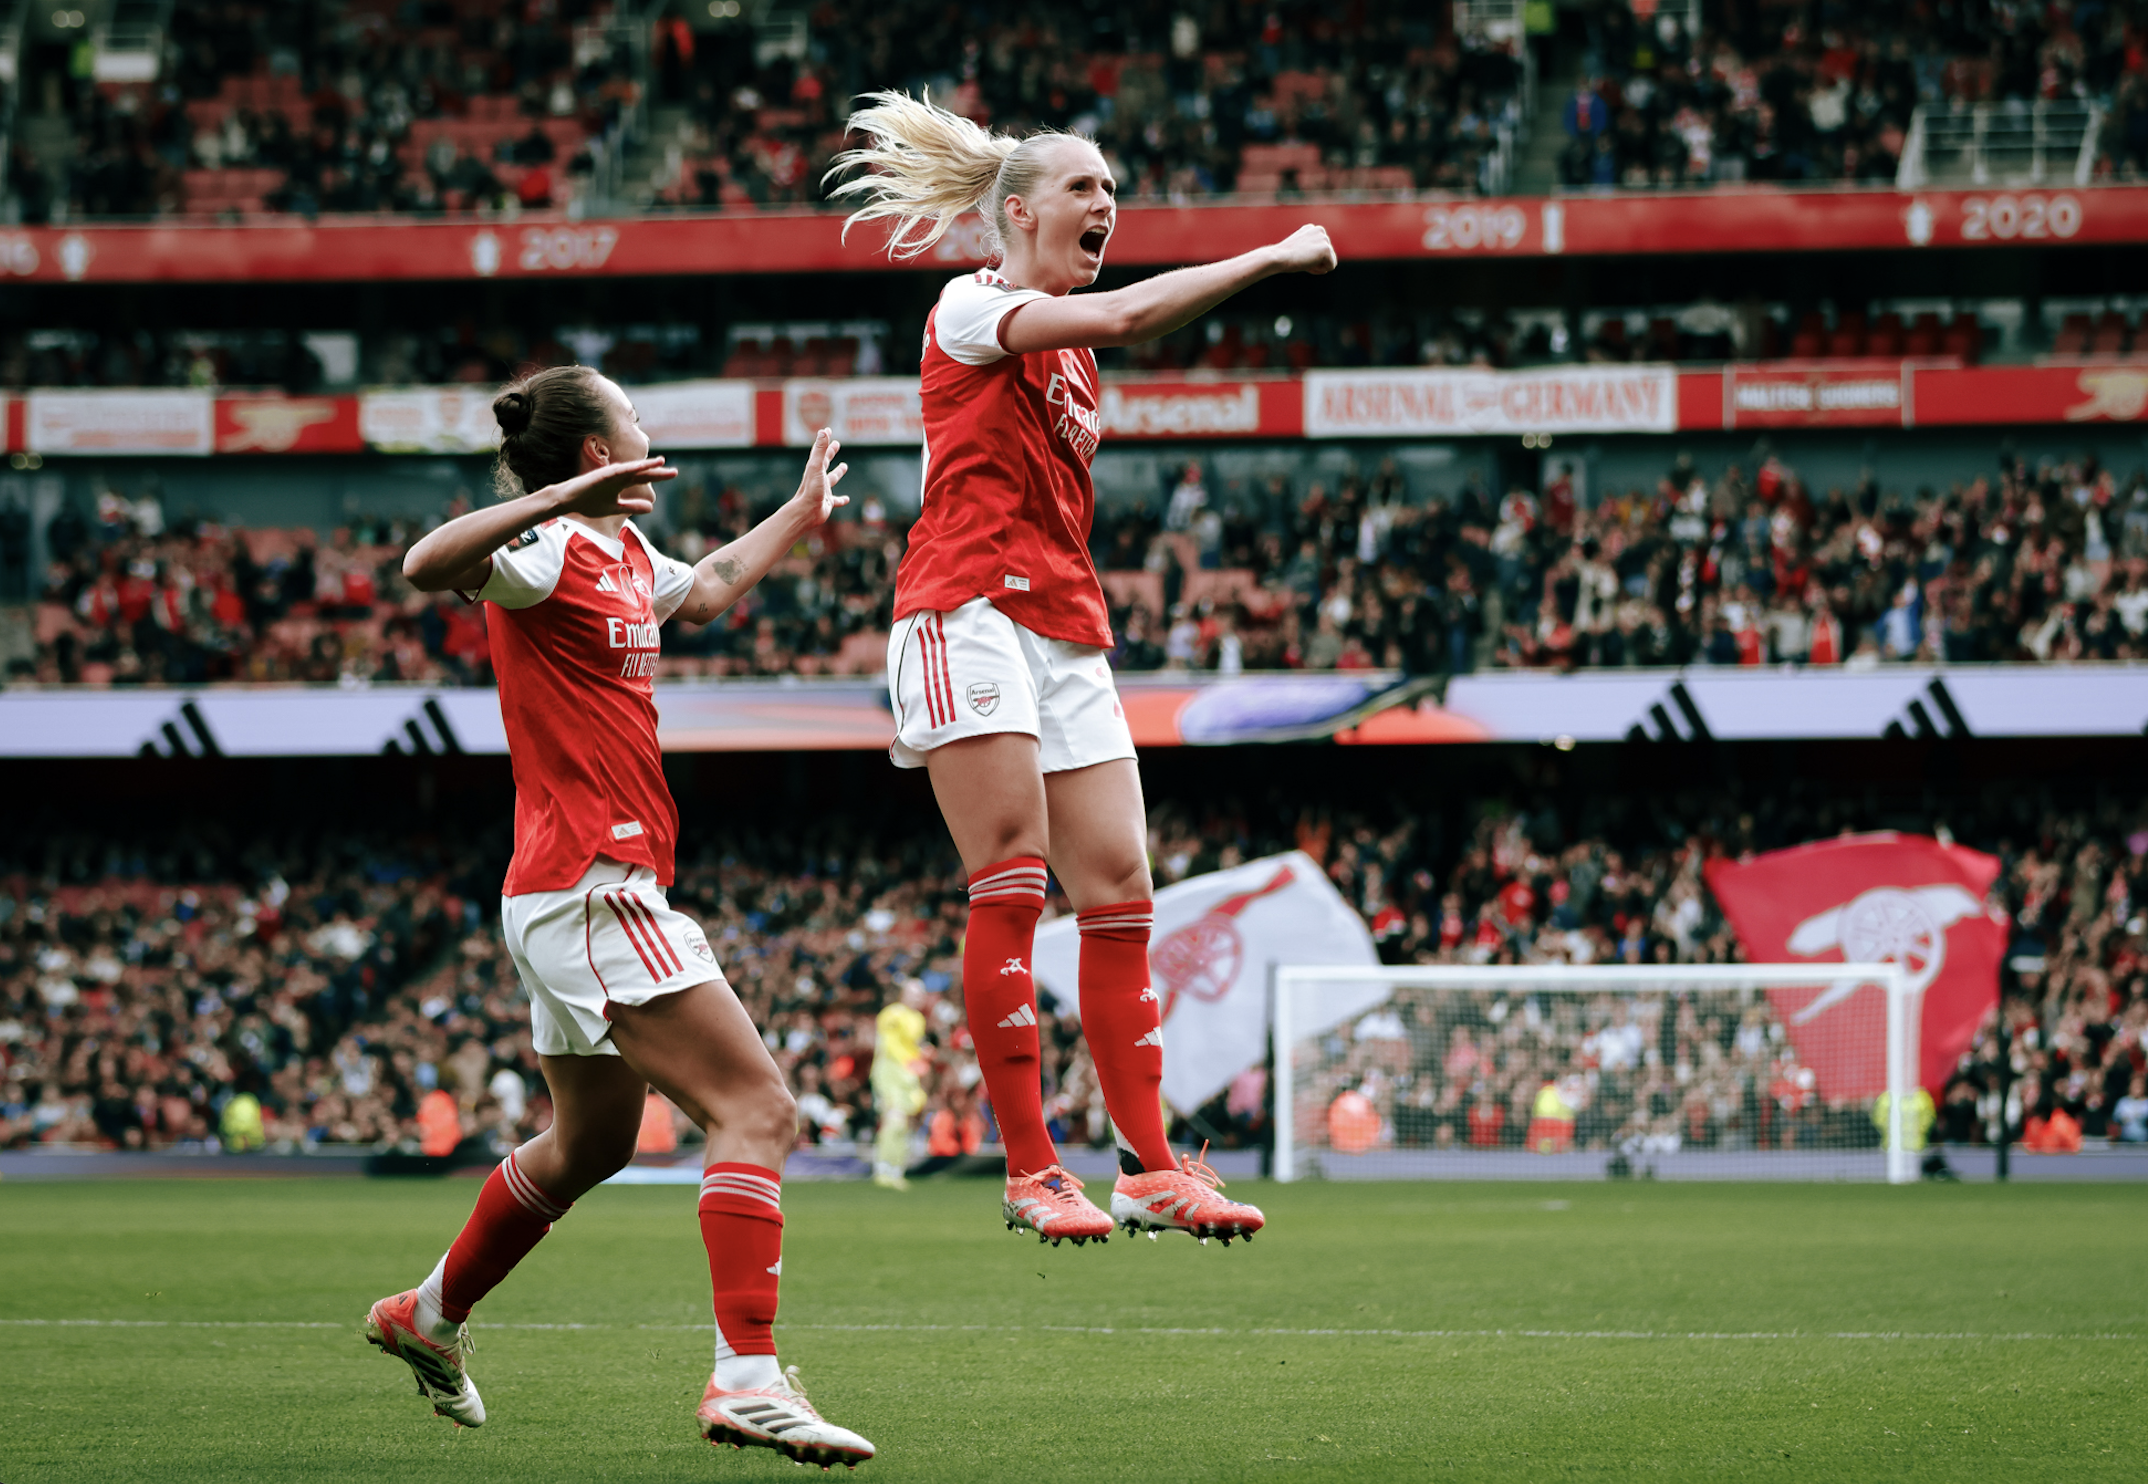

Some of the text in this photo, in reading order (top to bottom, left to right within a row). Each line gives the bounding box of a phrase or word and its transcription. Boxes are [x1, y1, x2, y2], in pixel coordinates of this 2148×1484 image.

[1422, 204, 1527, 250] 2019
[1961, 195, 2083, 239] 2020
[520, 226, 619, 270] 2017
[1098, 384, 1260, 434] Arsenal
[1322, 376, 1658, 425] ARSENAL GERMANY
[620, 652, 660, 678] FLY BETTE
[971, 687, 995, 696] Arsenal
